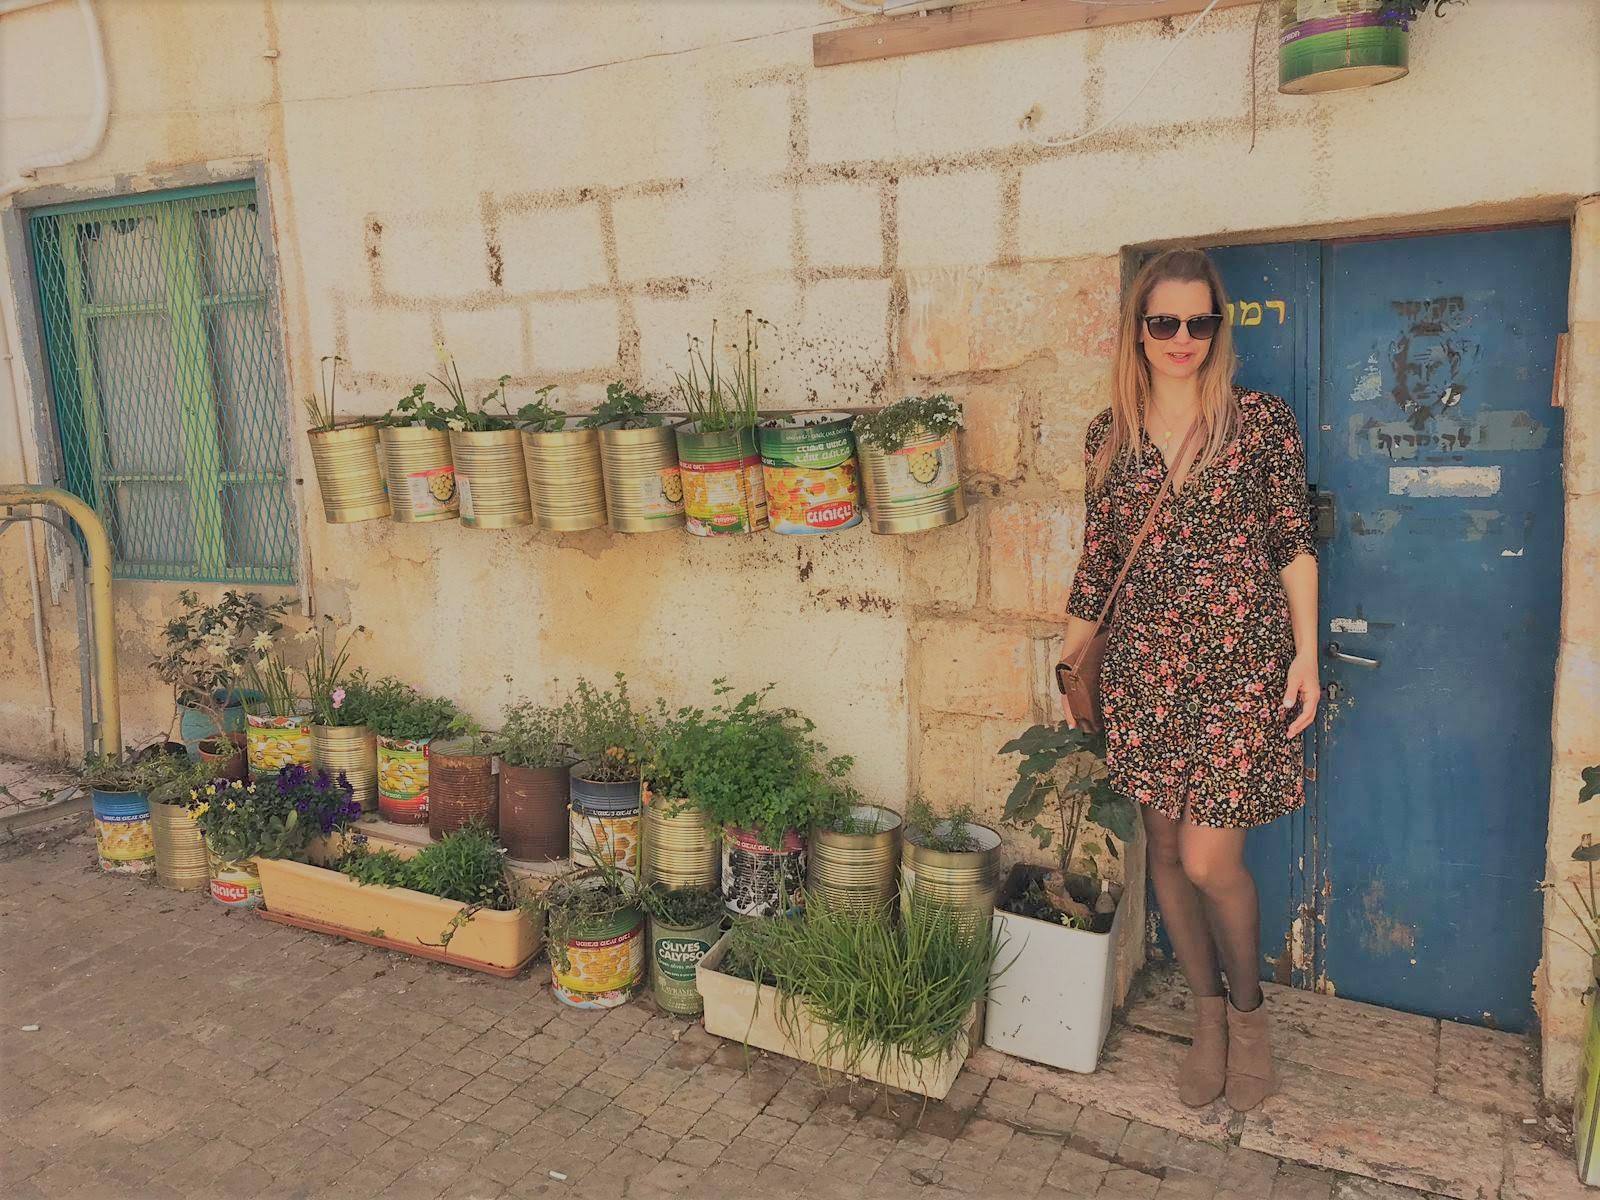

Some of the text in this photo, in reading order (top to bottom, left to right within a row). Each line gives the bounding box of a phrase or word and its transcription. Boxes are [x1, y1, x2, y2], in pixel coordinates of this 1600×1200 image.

[1226, 299, 1286, 325] רמו
[807, 504, 852, 524] מוטולה
[658, 948, 705, 962] CALYPSO
